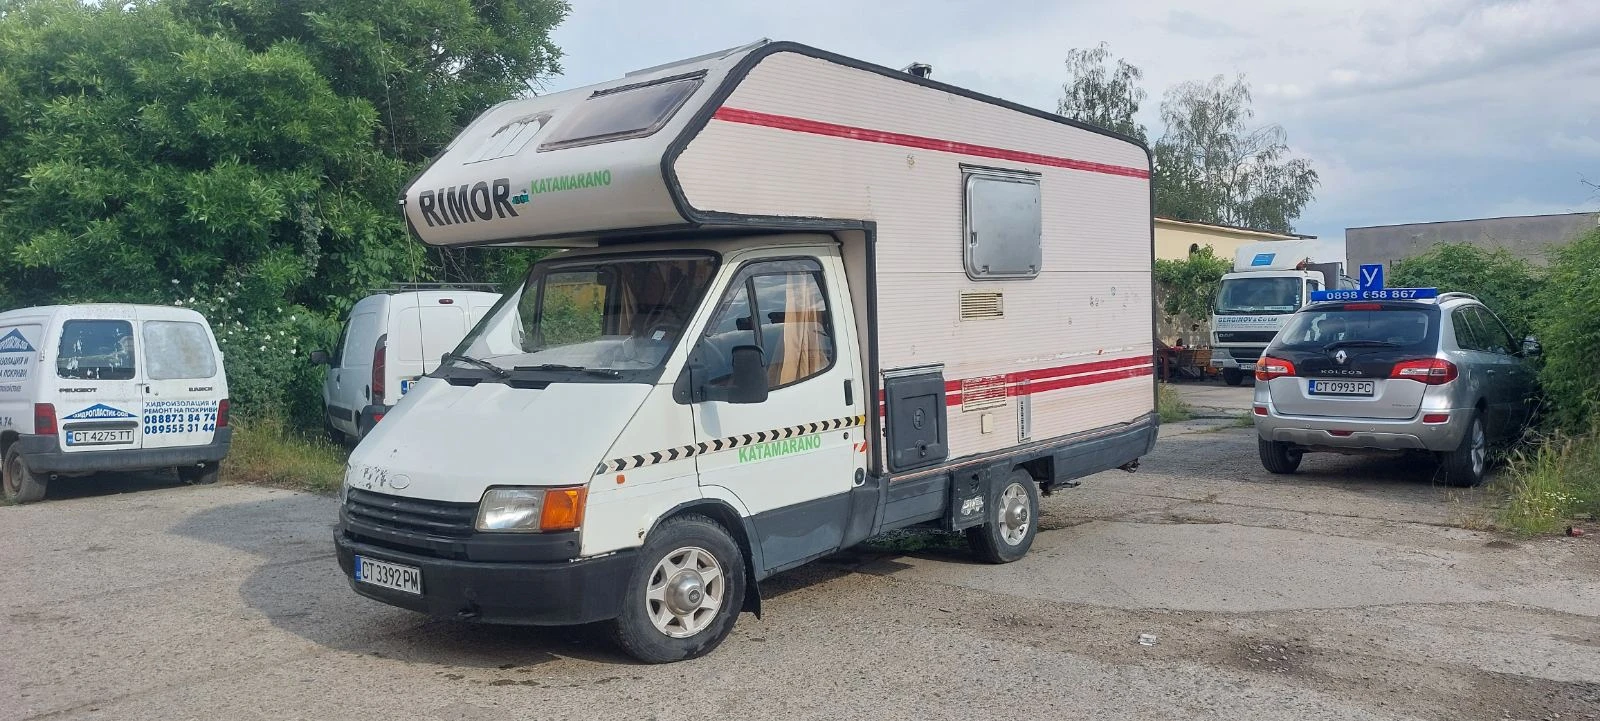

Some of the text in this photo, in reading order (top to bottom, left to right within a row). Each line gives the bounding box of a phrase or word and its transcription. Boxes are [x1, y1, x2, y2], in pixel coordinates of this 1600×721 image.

[531, 169, 612, 194] KATAMARANO
[419, 178, 519, 227] RIMOR
[1326, 291, 1358, 300] 0898
[1391, 290, 1417, 298] 867
[1316, 382, 1371, 393] CT 0993 PC
[145, 400, 209, 408] ХИДРОИЗОЛАЦИЯ
[144, 413, 216, 424] 088873 84 74
[144, 423, 214, 434] 089555 31 44
[74, 430, 131, 442] CT 4275 TT
[738, 434, 821, 463] KATAMARANO
[362, 561, 418, 591] CT 3392 PM
